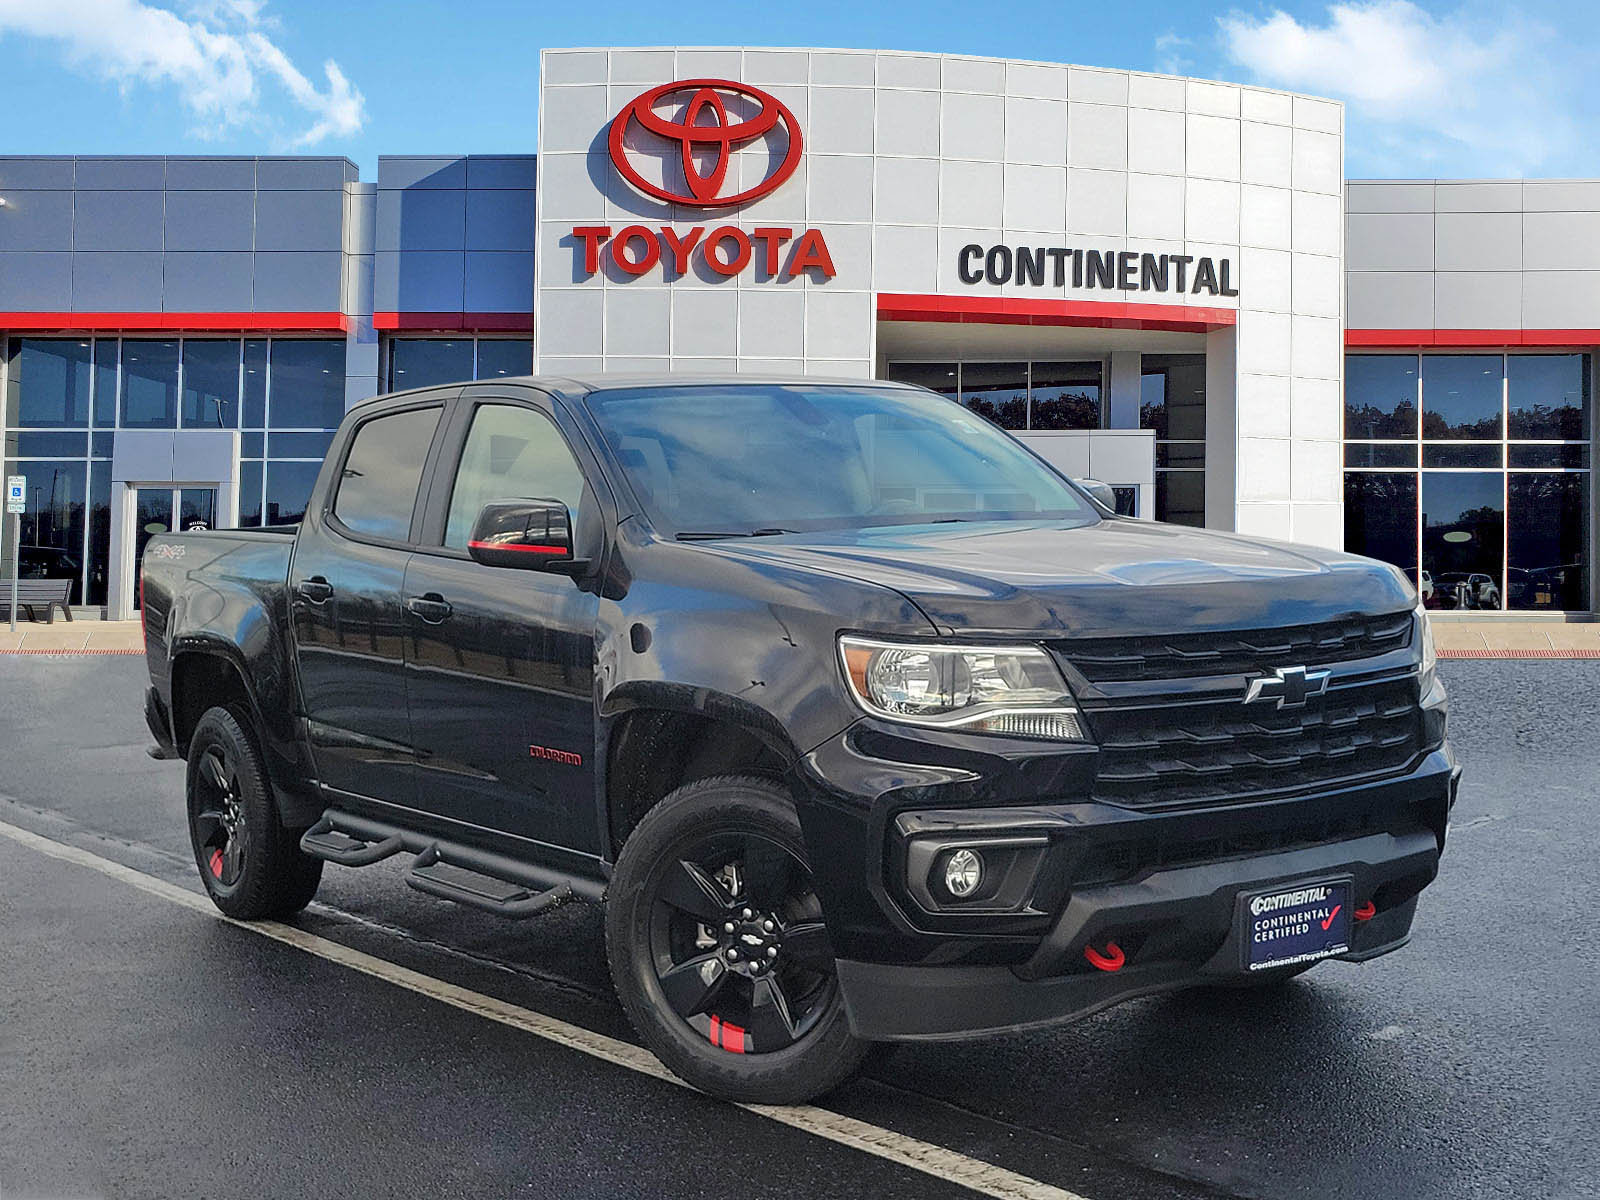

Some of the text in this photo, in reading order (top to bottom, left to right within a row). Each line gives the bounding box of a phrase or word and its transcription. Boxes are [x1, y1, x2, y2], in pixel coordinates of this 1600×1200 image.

[573, 225, 837, 277] TOYOTA
[958, 244, 1239, 297] CONTINENTAL
[1254, 908, 1330, 931] CONTINENTAL
[1254, 923, 1309, 942] CERTIFIED
[1249, 946, 1349, 970] ContinentalToyota.com
